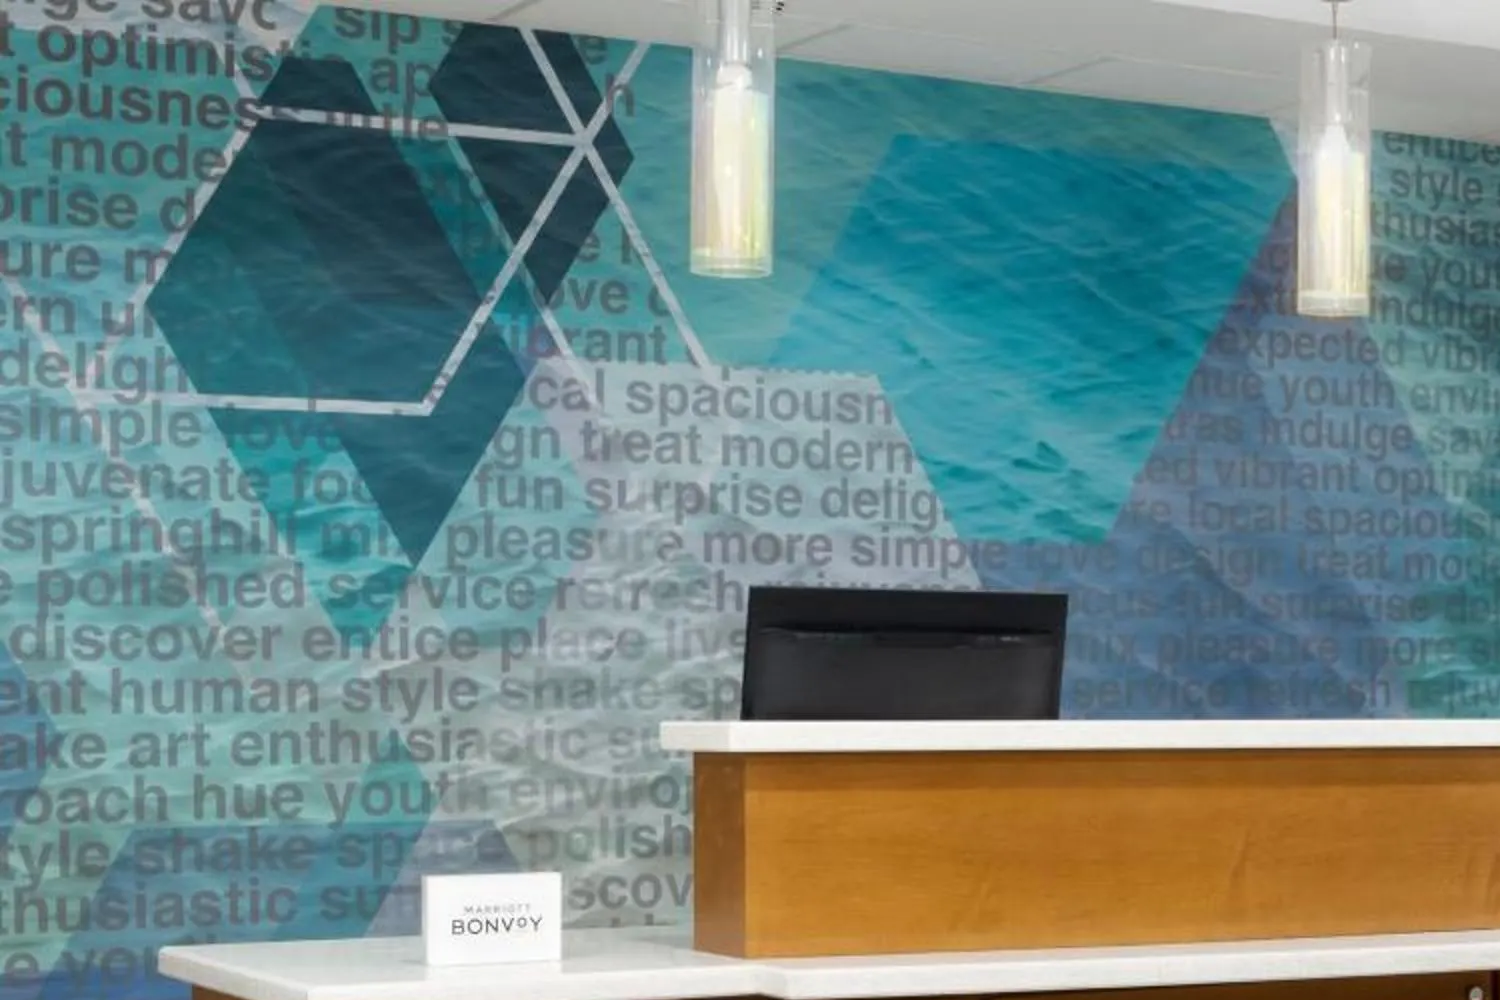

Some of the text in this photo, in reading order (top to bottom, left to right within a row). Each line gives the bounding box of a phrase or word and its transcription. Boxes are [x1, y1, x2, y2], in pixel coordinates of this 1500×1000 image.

[1390, 165, 1484, 213] style
[1279, 369, 1395, 412] youth
[0, 394, 202, 456] simple
[579, 419, 704, 467] treat
[722, 428, 913, 474] modern
[1260, 409, 1414, 462] indulge
[474, 468, 564, 512] fun
[583, 472, 804, 525] surprise
[1212, 449, 1362, 494] vibrant
[1188, 491, 1290, 533] local
[2, 507, 298, 566] springhill
[447, 508, 685, 573] pleasure
[702, 529, 833, 566] more
[850, 526, 1010, 580] simple
[37, 559, 306, 622] polished
[328, 563, 538, 613] service
[8, 612, 284, 663] discover
[302, 613, 481, 663] entice
[503, 616, 649, 673] place
[110, 666, 320, 716] human
[342, 668, 481, 725] style
[501, 664, 661, 713] shake
[128, 723, 212, 770] art
[230, 718, 588, 767] enthusiastic
[193, 772, 306, 821] hue
[325, 768, 488, 830] youth
[134, 825, 318, 878] shake
